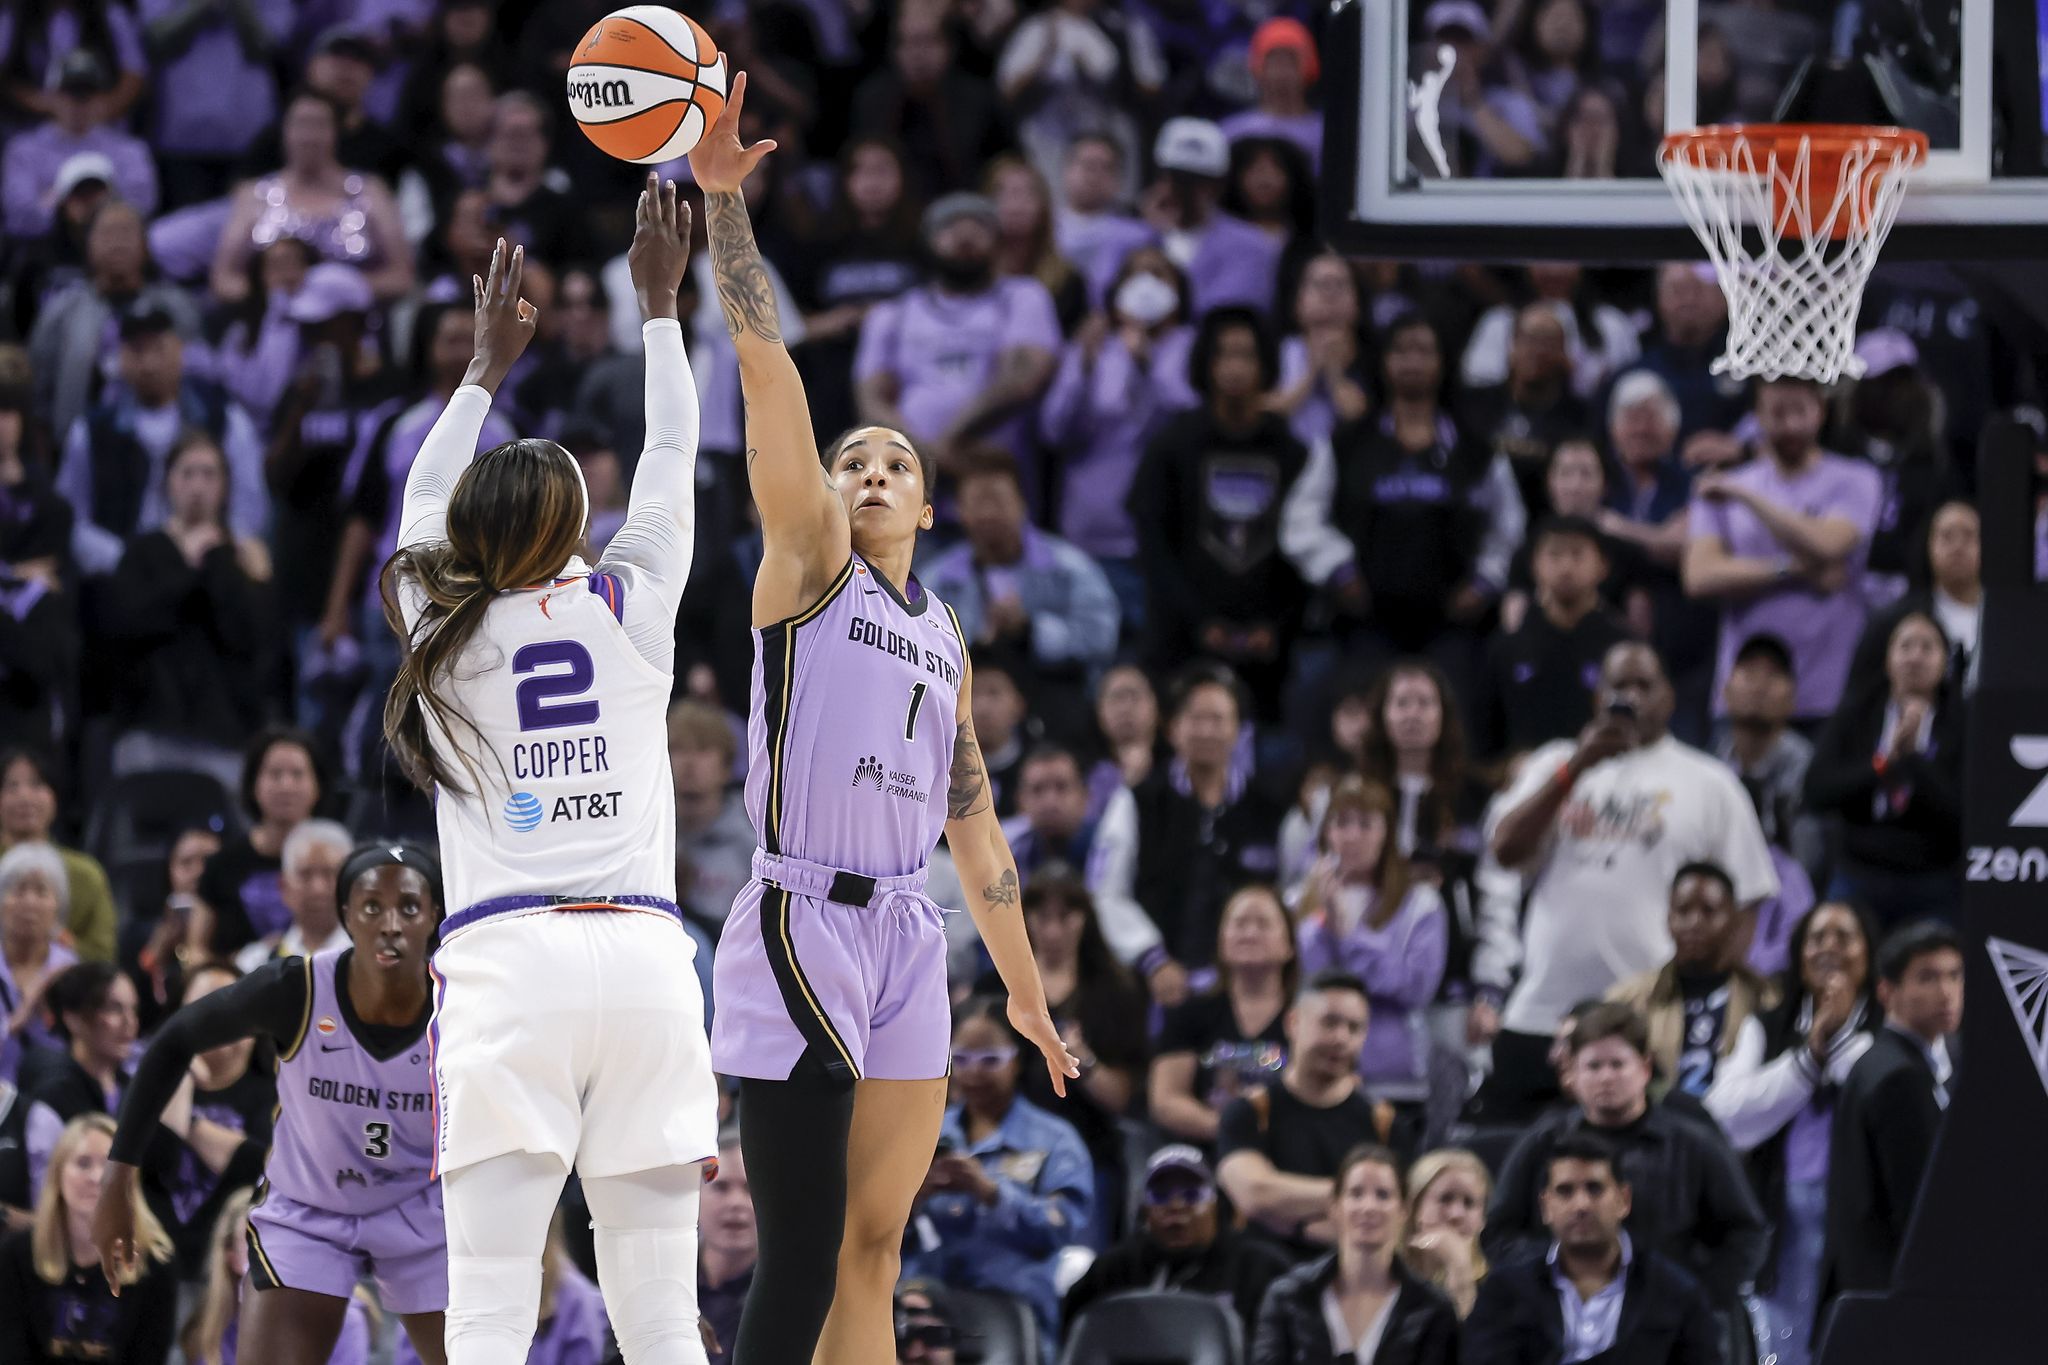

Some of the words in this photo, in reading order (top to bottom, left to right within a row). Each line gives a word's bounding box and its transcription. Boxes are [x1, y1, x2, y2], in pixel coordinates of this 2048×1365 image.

[568, 80, 634, 109] Wilso
[848, 616, 919, 666] GOLDEN
[512, 639, 601, 732] 2
[904, 680, 928, 742] 1
[513, 735, 609, 779] COPPER
[889, 770, 916, 786] KAISER
[551, 791, 623, 822] AT&T
[1966, 846, 2048, 882] zen
[309, 1077, 380, 1109] GOLDEN
[364, 1120, 391, 1160] 3
